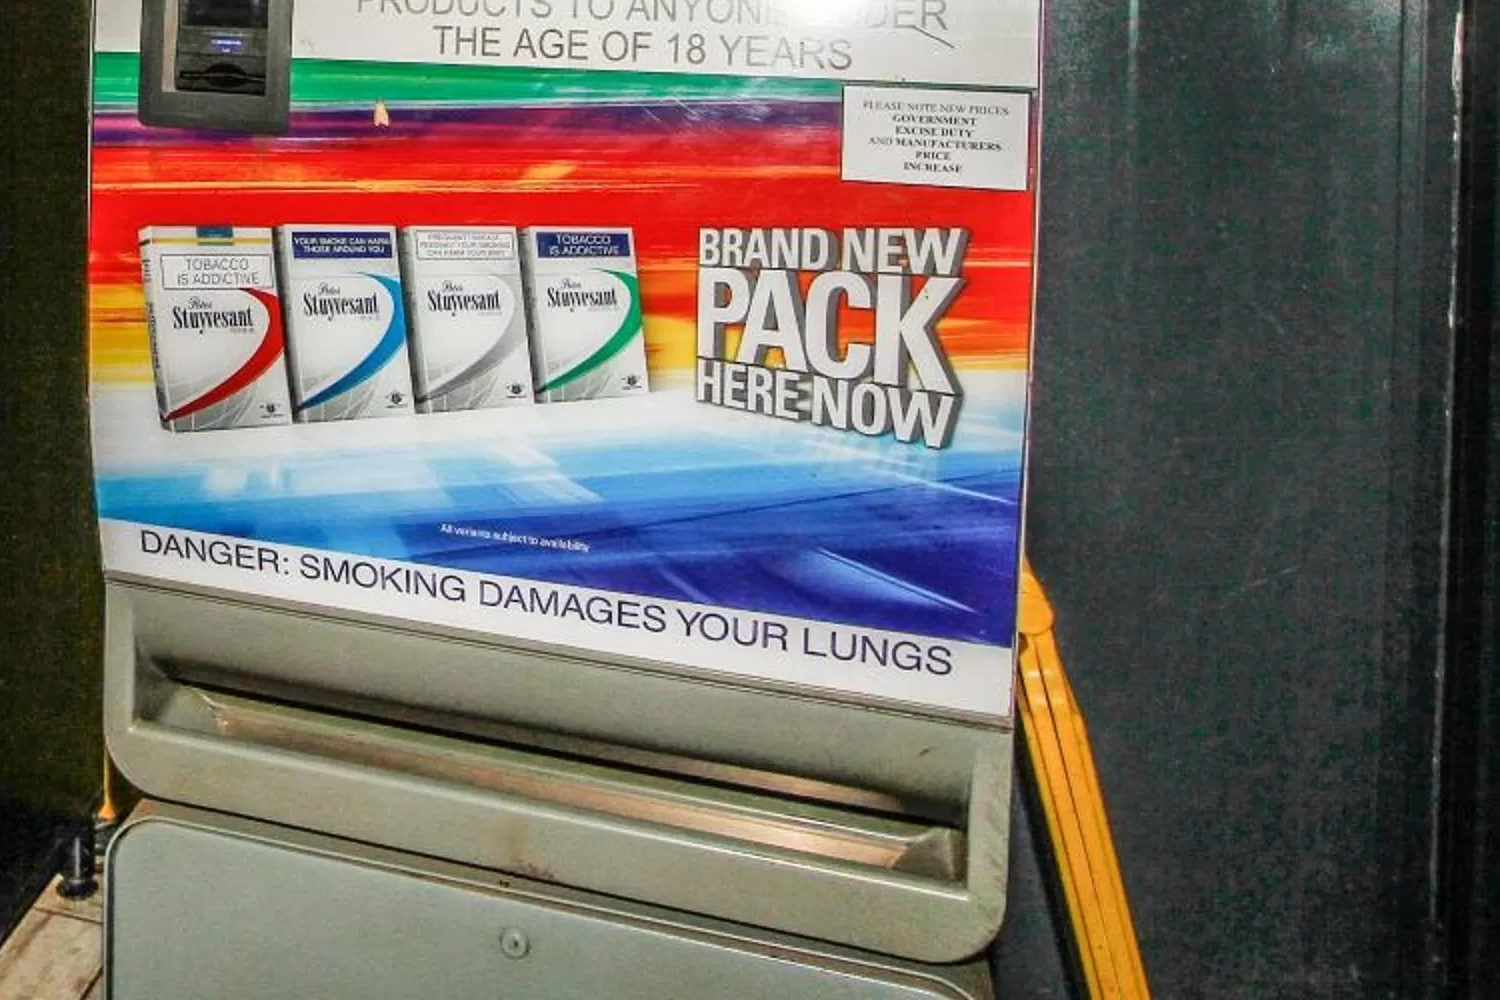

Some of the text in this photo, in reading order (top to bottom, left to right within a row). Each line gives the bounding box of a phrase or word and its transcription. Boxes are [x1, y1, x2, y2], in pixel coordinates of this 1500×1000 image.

[433, 25, 853, 71] THE AGE OF 18 YEARS
[863, 101, 1010, 116] PLEASE NOTE NEW PRICES
[892, 115, 978, 127] GOVERNMENT
[895, 126, 975, 139] EXCISE DUTY
[868, 137, 1002, 151] AND MANUFACTURERS
[915, 151, 951, 161] PRICE
[903, 162, 963, 174] INCREASE
[556, 233, 611, 245] TOBACCO
[563, 245, 620, 256] ADDICTIVE
[699, 227, 966, 276] BRAND NEW
[184, 258, 250, 271] TOBACCO
[177, 271, 260, 285] IS ADDICTIVE
[303, 292, 380, 317] Stuyvesant
[427, 290, 500, 312] Stuyvesant
[547, 287, 617, 308] Stuyvesant
[173, 306, 253, 331] Stuyvesant
[698, 268, 962, 395] PACK
[698, 358, 956, 450] HERE NOW
[141, 530, 953, 676] DANGER: SMOKING DAMAGES YOUR LUNGS
